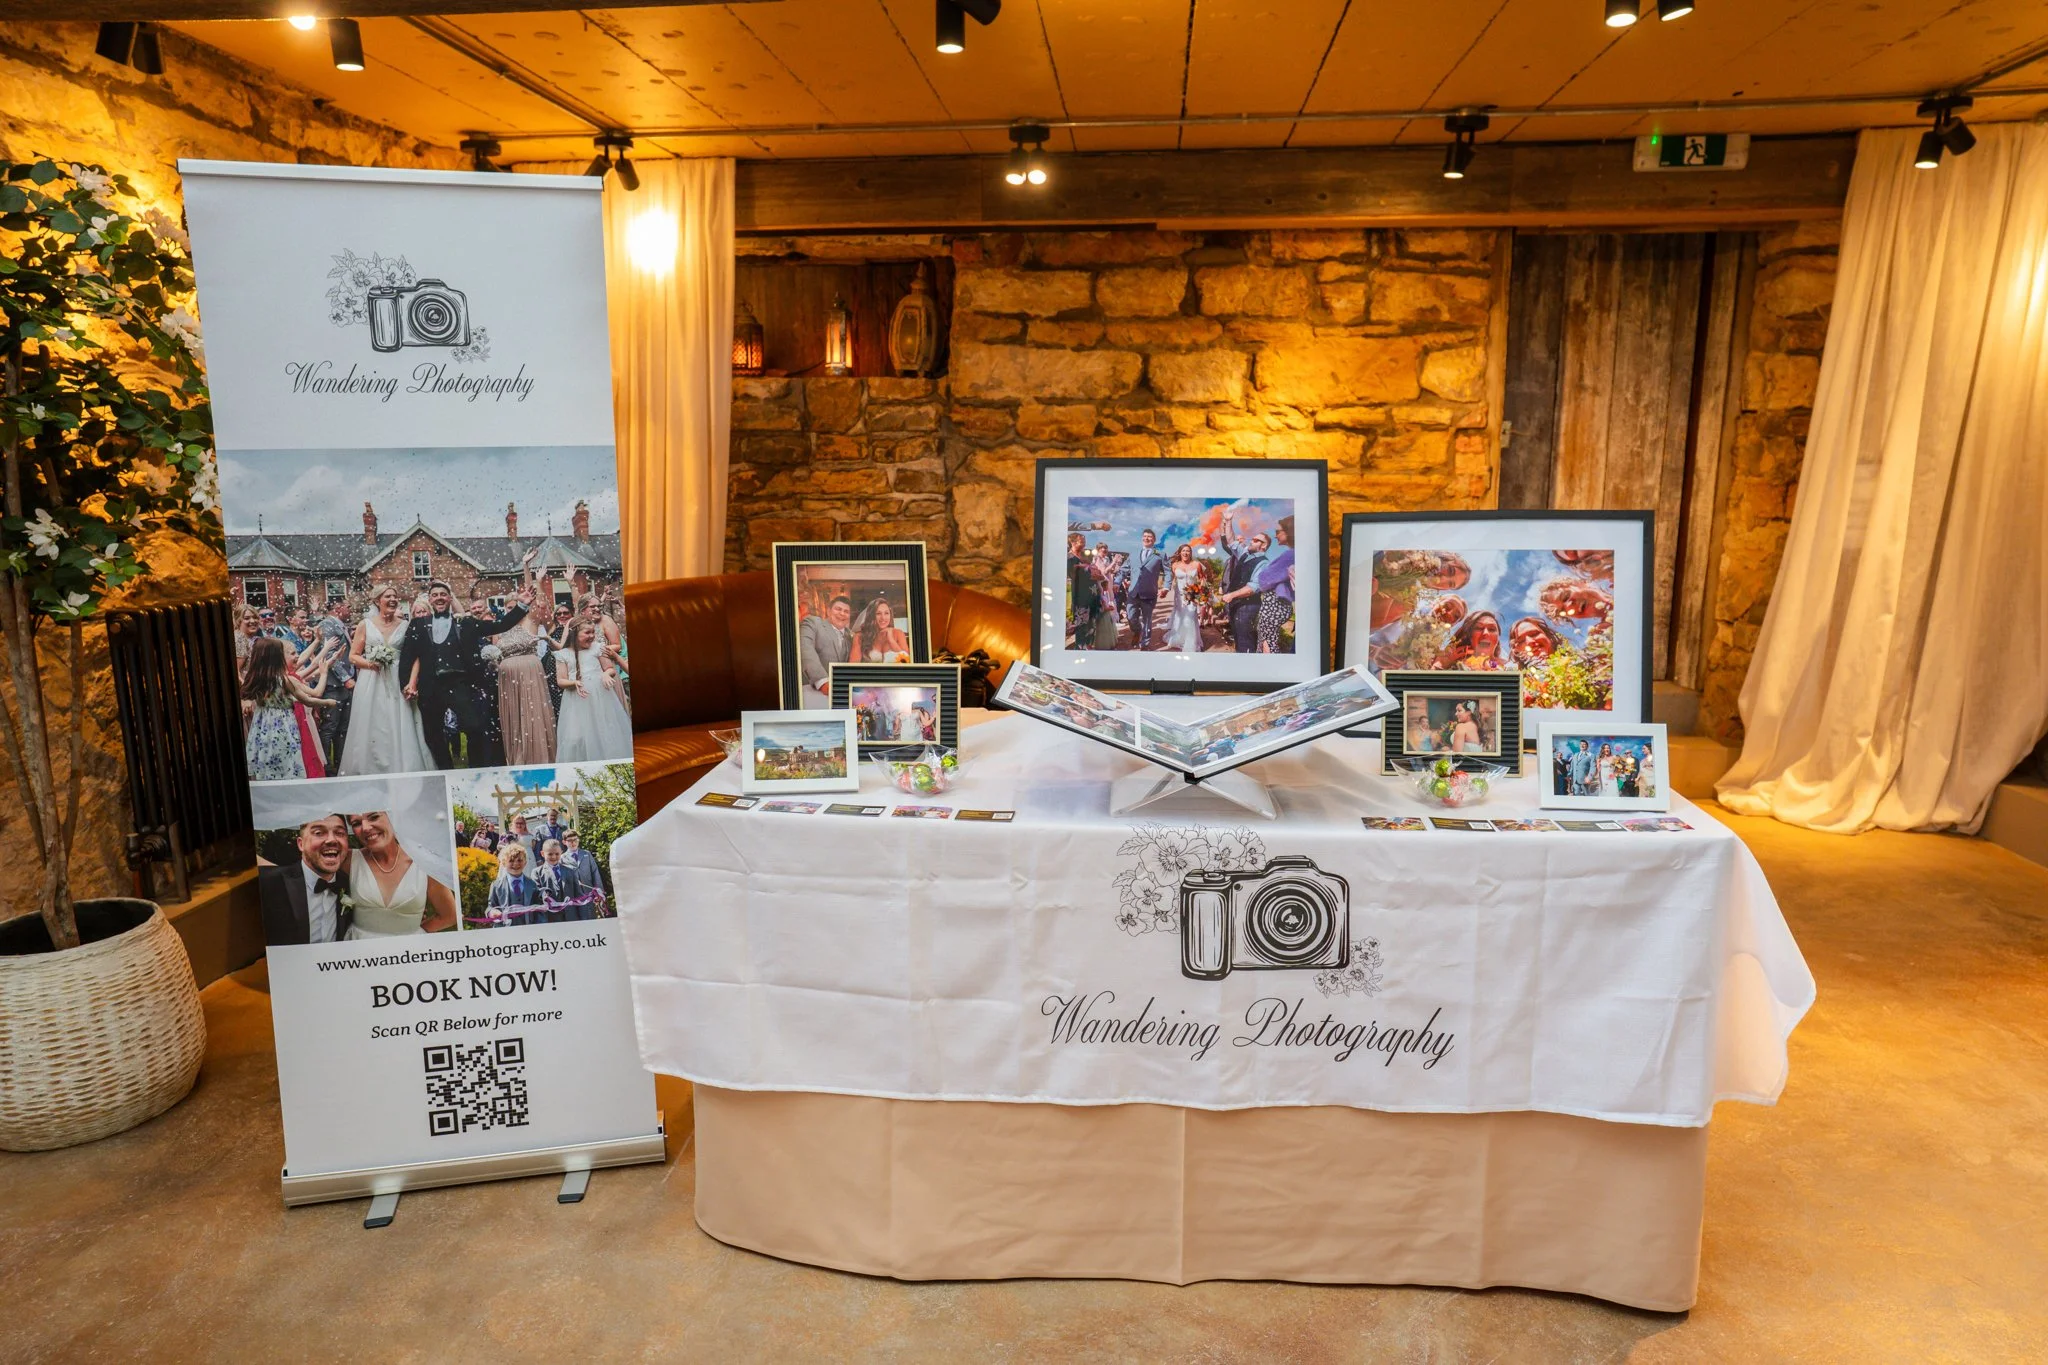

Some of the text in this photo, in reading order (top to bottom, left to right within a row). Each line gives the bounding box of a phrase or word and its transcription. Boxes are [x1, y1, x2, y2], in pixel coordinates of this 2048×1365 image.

[285, 361, 535, 402] Wandering Photography
[317, 934, 607, 971] www.wanderingphotography.co.uk
[371, 969, 557, 1008] BOOK NOW!
[371, 1008, 563, 1039] Scan QR Below for more
[1041, 990, 1454, 1070] Wandering Photography
